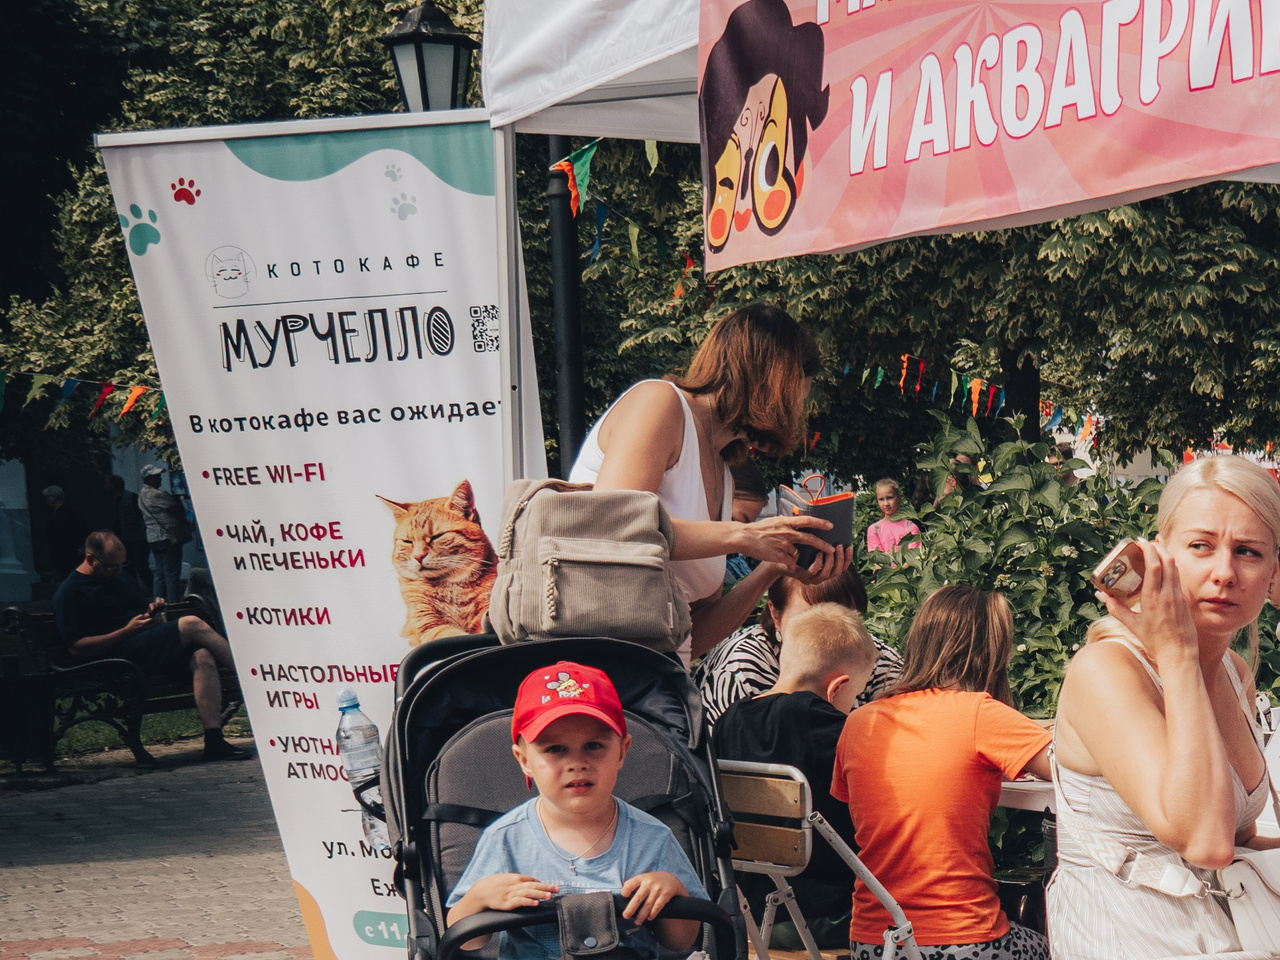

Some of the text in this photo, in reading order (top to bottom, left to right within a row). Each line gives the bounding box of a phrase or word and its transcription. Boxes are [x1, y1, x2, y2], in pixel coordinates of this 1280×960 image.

[849, 68, 894, 176] И
[266, 252, 445, 279] КОТОКАФЕ
[219, 305, 456, 372] МУРЧЕЛЛО
[190, 399, 501, 434] В котокафе вас ожидае
[212, 462, 325, 486] FREE WI-FI
[225, 519, 344, 547] ЧАЙ, КОФЕ
[249, 549, 366, 571] ПЕЧЕНЬКИ
[246, 606, 331, 626] КОТИКИ
[260, 664, 400, 684] НАСТОЛЬНЫЕ
[266, 690, 320, 710] ИГРЫ
[322, 840, 356, 859] ул.
